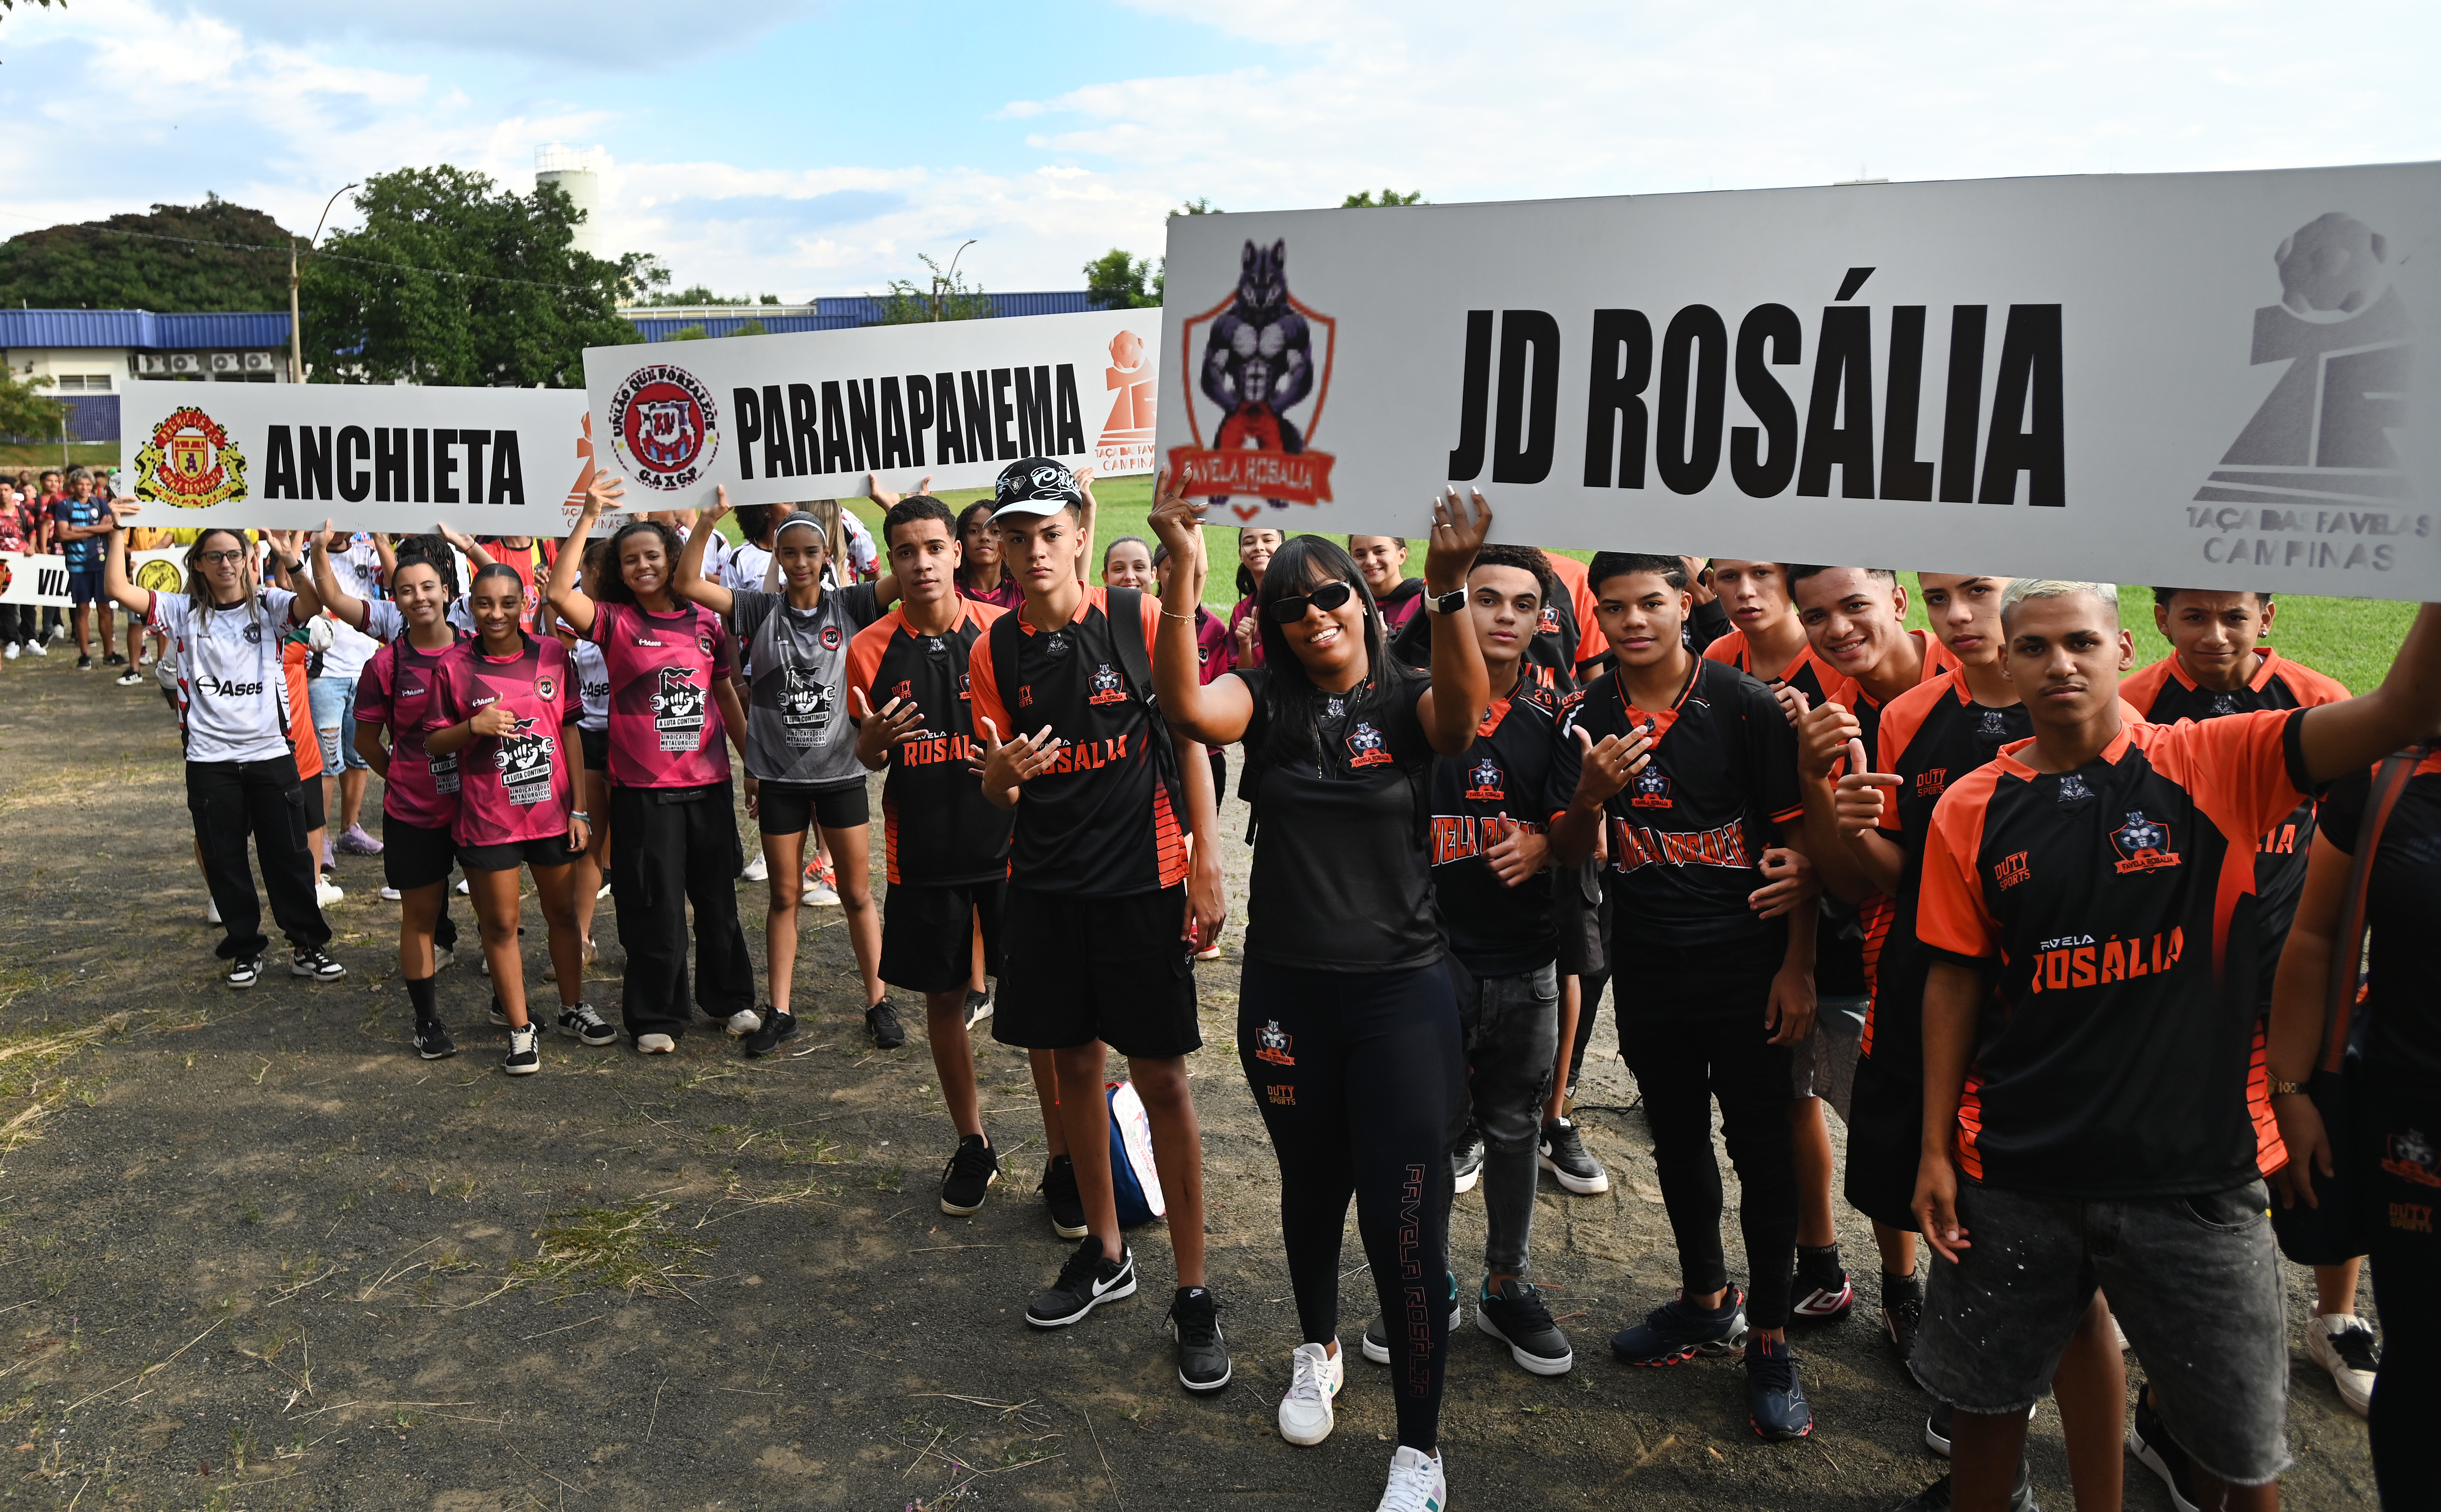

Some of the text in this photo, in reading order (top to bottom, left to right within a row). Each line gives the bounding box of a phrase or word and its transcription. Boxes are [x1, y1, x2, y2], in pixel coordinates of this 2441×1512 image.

[1448, 267, 2066, 507] JD ROSÁLIA
[733, 363, 1086, 480] PARANAPANEMA
[264, 424, 525, 505] ANCHIETA
[1103, 457, 1155, 471] CAMPINA
[567, 518, 622, 529] CPINAS
[2186, 506, 2252, 534] TAÇA
[2316, 511, 2432, 538] FAVELAS
[2203, 537, 2396, 571] CAMPINAS
[219, 680, 263, 696] Ases
[587, 681, 610, 698] Ase
[891, 680, 911, 695] DUTY
[914, 731, 947, 740] VELA
[903, 732, 975, 767] ROSÁL
[1033, 734, 1128, 776] SÁLIA
[438, 762, 450, 770] LUTA
[511, 773, 523, 781] LUTA
[1916, 768, 1947, 787] DUTY
[509, 785, 538, 795] SINDICATO
[1918, 785, 1945, 797] SPORTS
[1430, 815, 1479, 867] VELA
[1994, 850, 2028, 880] DUTY
[2122, 860, 2146, 870] FAVELA
[2000, 869, 2031, 891] SPORTS
[1267, 1085, 1295, 1098] DUTY
[1269, 1096, 1296, 1105] SPORTS
